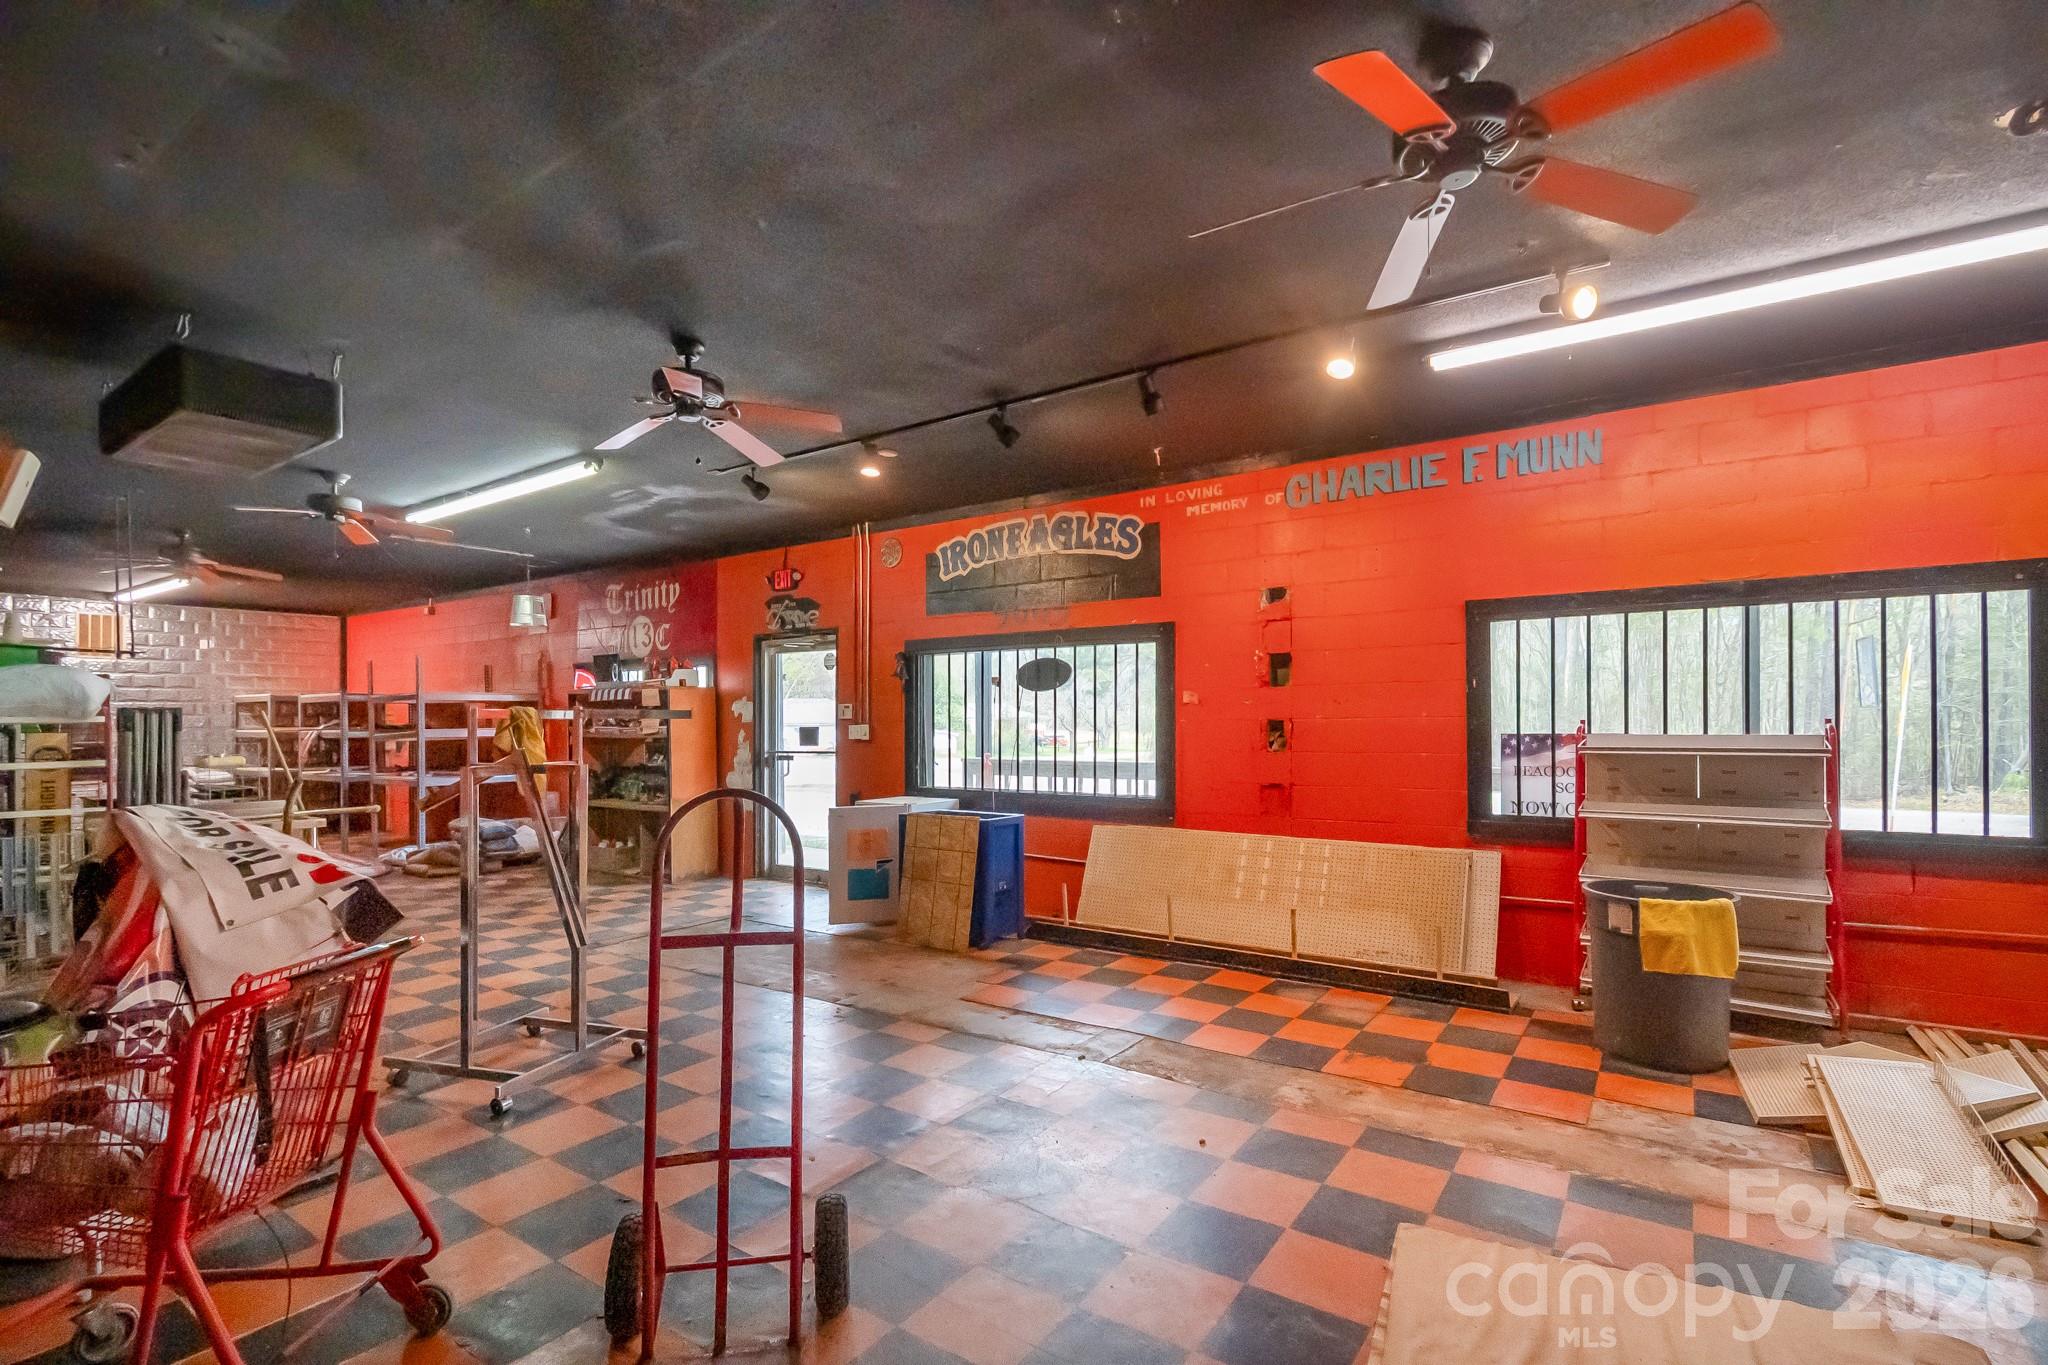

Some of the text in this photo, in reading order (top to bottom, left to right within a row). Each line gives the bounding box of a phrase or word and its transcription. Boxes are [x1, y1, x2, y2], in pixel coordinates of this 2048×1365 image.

[1284, 428, 1604, 509] CHARLIE F. MUNN
[1140, 484, 1224, 508] IN LOVING
[1186, 492, 1285, 517] MEMORY OF
[774, 569, 791, 590] EXIT
[607, 580, 680, 615] Trinity
[655, 624, 672, 650] C
[212, 840, 300, 900] SALE
